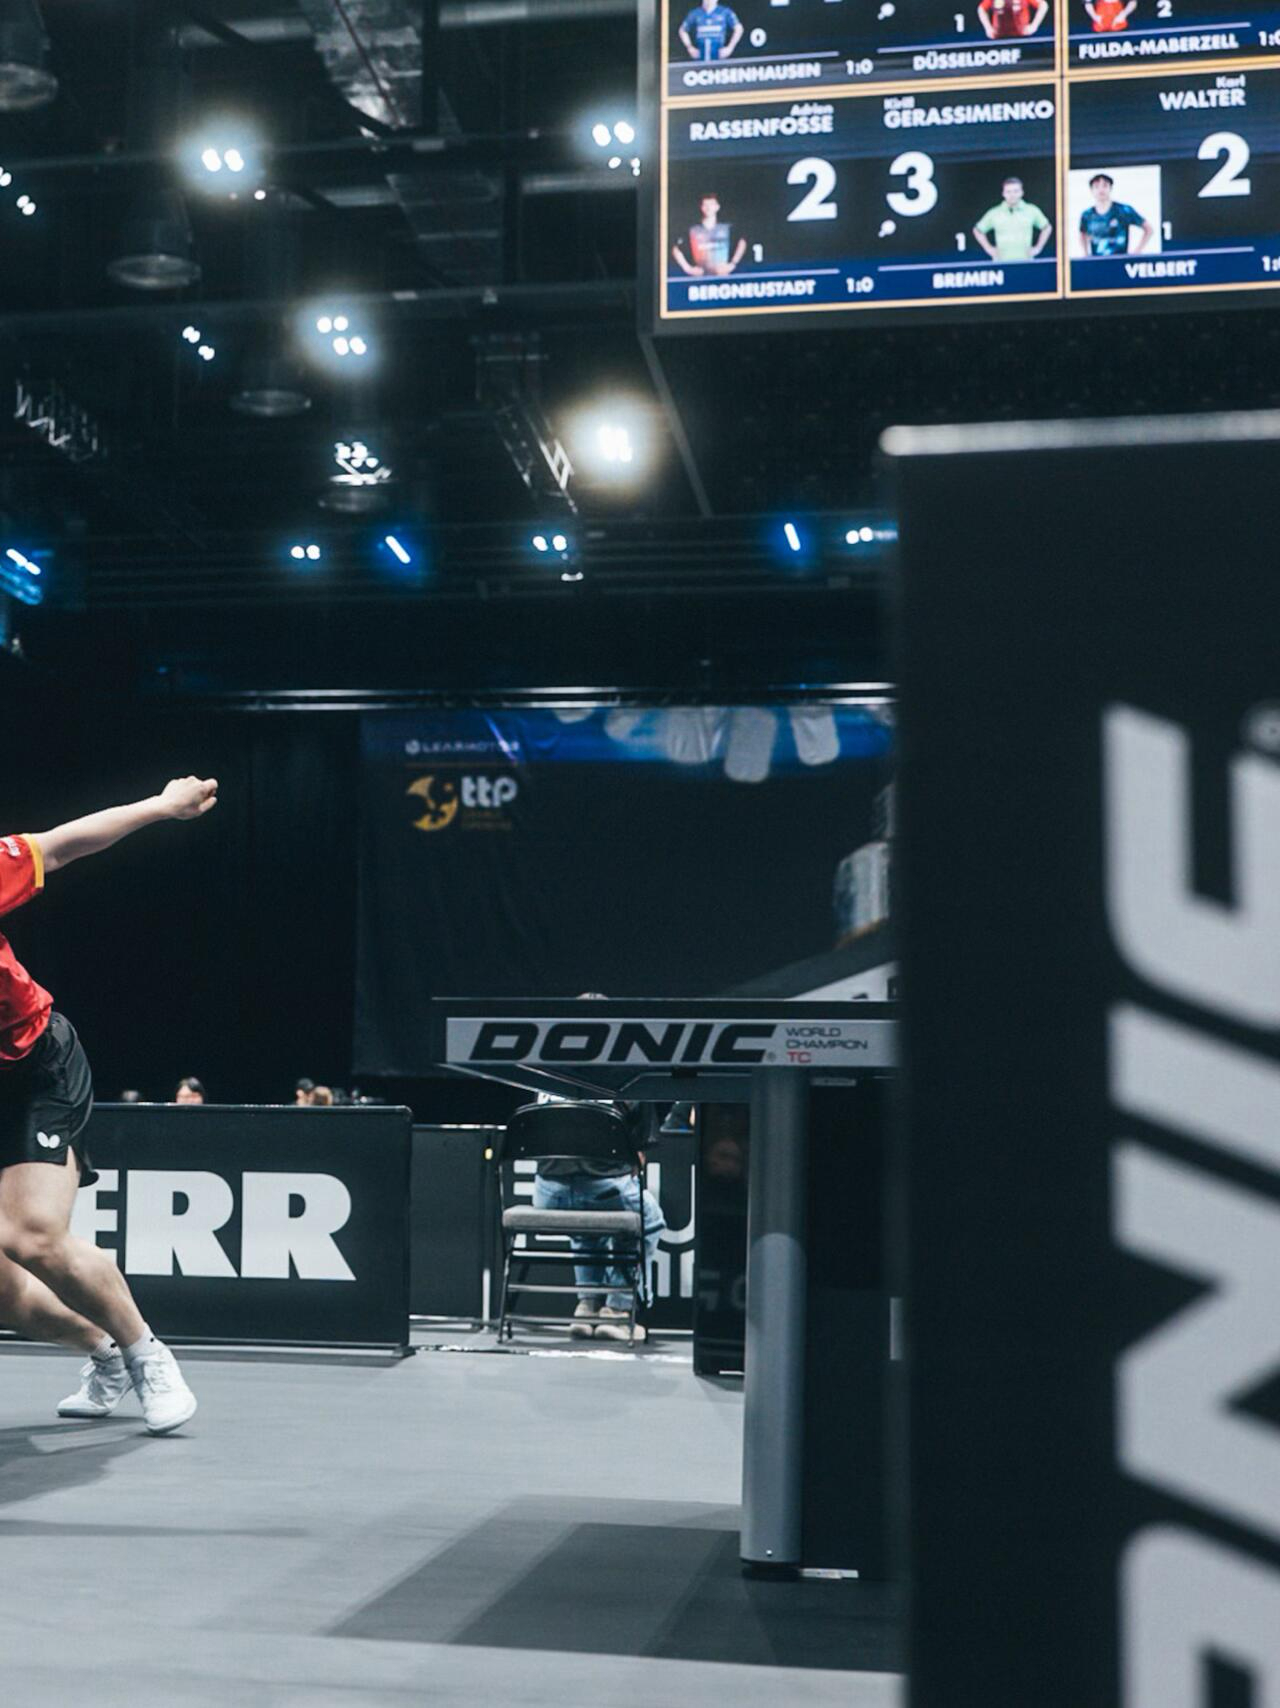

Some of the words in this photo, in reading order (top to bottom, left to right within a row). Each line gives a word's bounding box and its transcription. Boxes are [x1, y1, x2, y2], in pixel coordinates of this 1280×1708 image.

[1157, 0, 1172, 17] 2
[954, 13, 964, 32] 1
[750, 28, 767, 47] 0
[1079, 33, 1239, 60] FULDA-MABERZELL
[846, 59, 874, 76] 1:0
[912, 48, 1021, 71] DÜSSELDORF
[683, 63, 821, 87] OCHSENHAUSEN
[1216, 75, 1246, 88] Karl
[1159, 88, 1246, 111] WALTER
[884, 100, 1054, 129] GERASSIMENKO
[690, 115, 834, 142] RASSENFOSSE
[1198, 132, 1250, 198] 2
[786, 157, 838, 222] 2
[886, 151, 938, 217] 3
[1162, 221, 1172, 240] 1
[955, 232, 966, 251] 1
[752, 243, 763, 262] 1
[1125, 260, 1197, 278] VELBERT
[846, 277, 874, 292] 1:0
[932, 270, 1004, 289] BREMEN
[688, 279, 816, 301] BERGNEUSTADT
[460, 776, 518, 808] ttp
[786, 1027, 842, 1037] WORLD
[468, 1022, 777, 1062] DONIC
[786, 1039, 868, 1049] CHAMPION
[787, 1051, 812, 1063] TC
